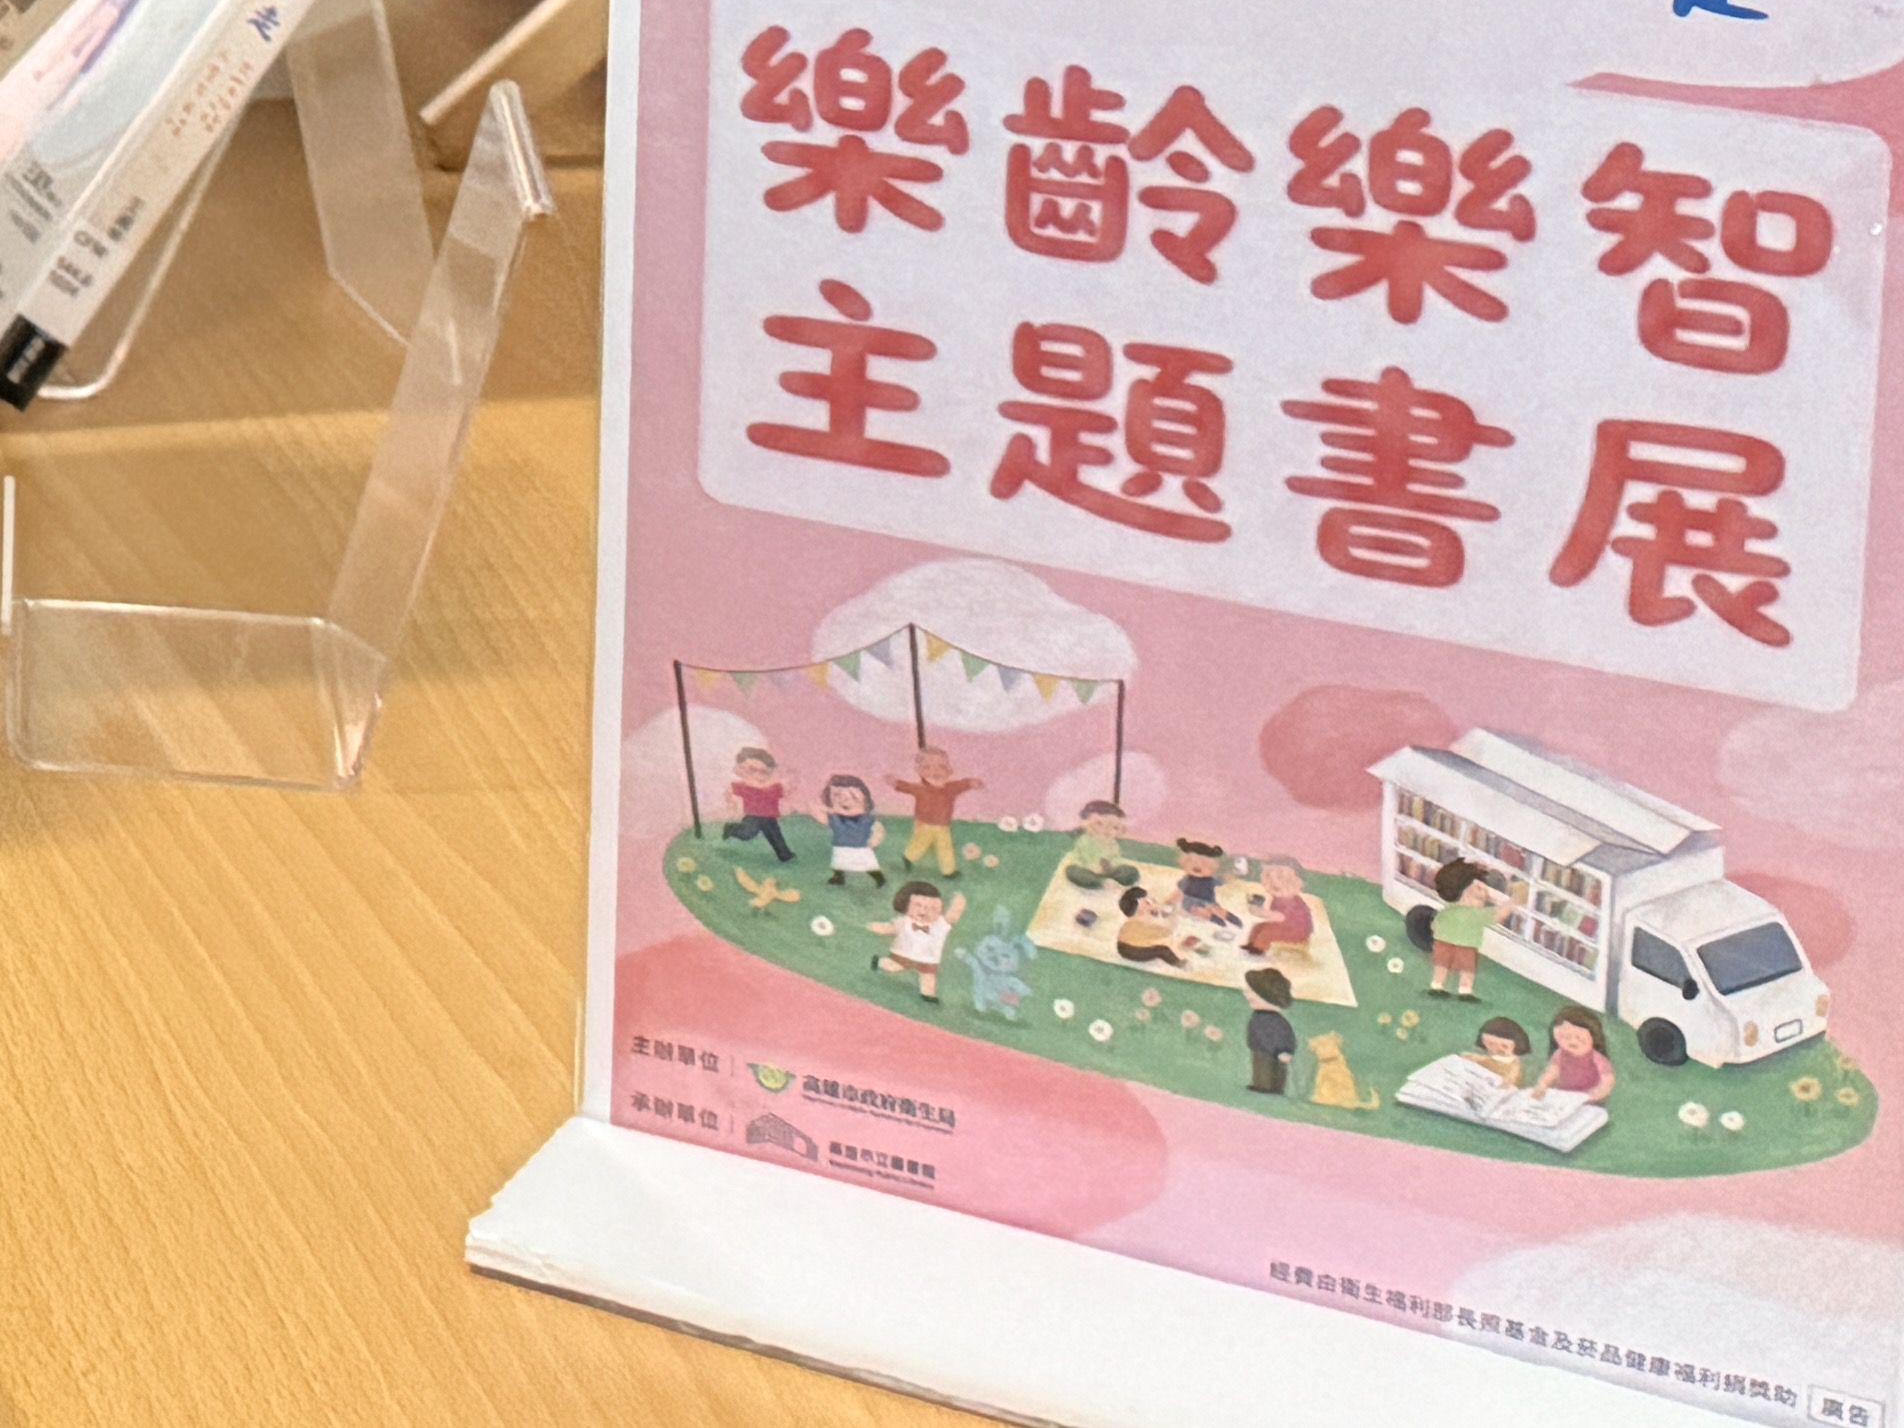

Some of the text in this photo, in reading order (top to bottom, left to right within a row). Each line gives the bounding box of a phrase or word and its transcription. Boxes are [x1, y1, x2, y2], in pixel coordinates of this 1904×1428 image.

[739, 24, 1835, 377] 樂齡樂智
[745, 278, 1794, 648] 主題書展
[631, 1035, 720, 1074] 主辦單位
[631, 1091, 719, 1131] 承辦單位
[1821, 1397, 1869, 1428] 廣告
